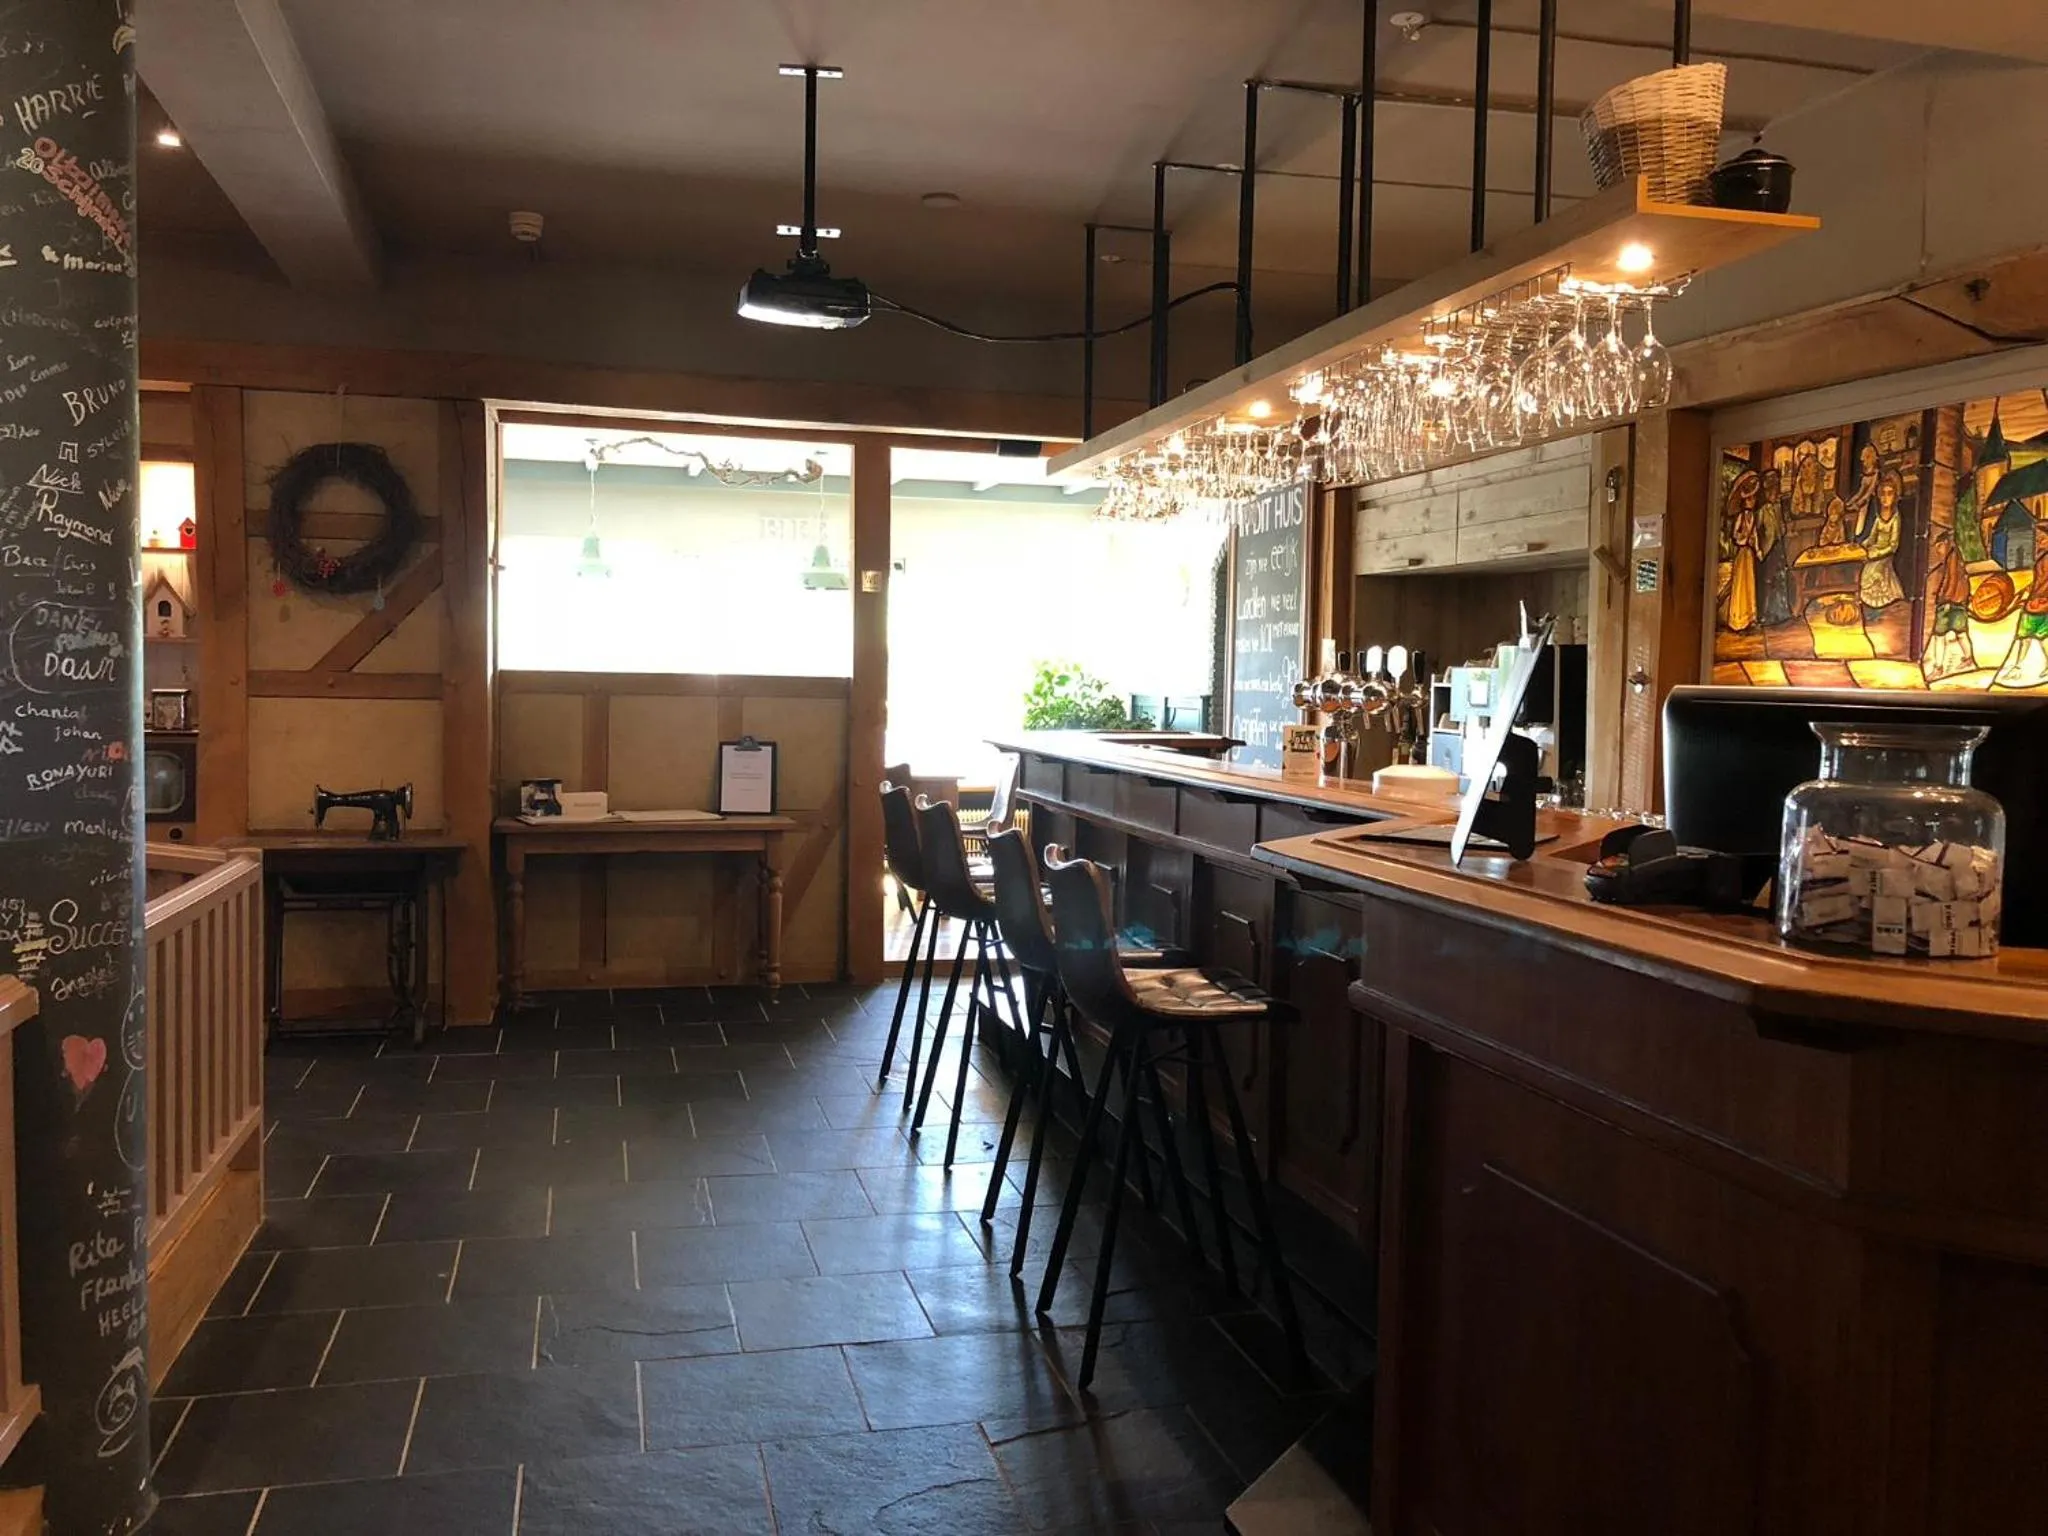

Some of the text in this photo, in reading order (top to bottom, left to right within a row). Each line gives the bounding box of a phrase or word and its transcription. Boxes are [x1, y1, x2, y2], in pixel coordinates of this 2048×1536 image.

[14, 74, 104, 135] HARRIE
[62, 379, 125, 426] BRUNO
[35, 487, 112, 546] Raymond
[1275, 488, 1303, 530] HUIS
[44, 652, 116, 681] Daan
